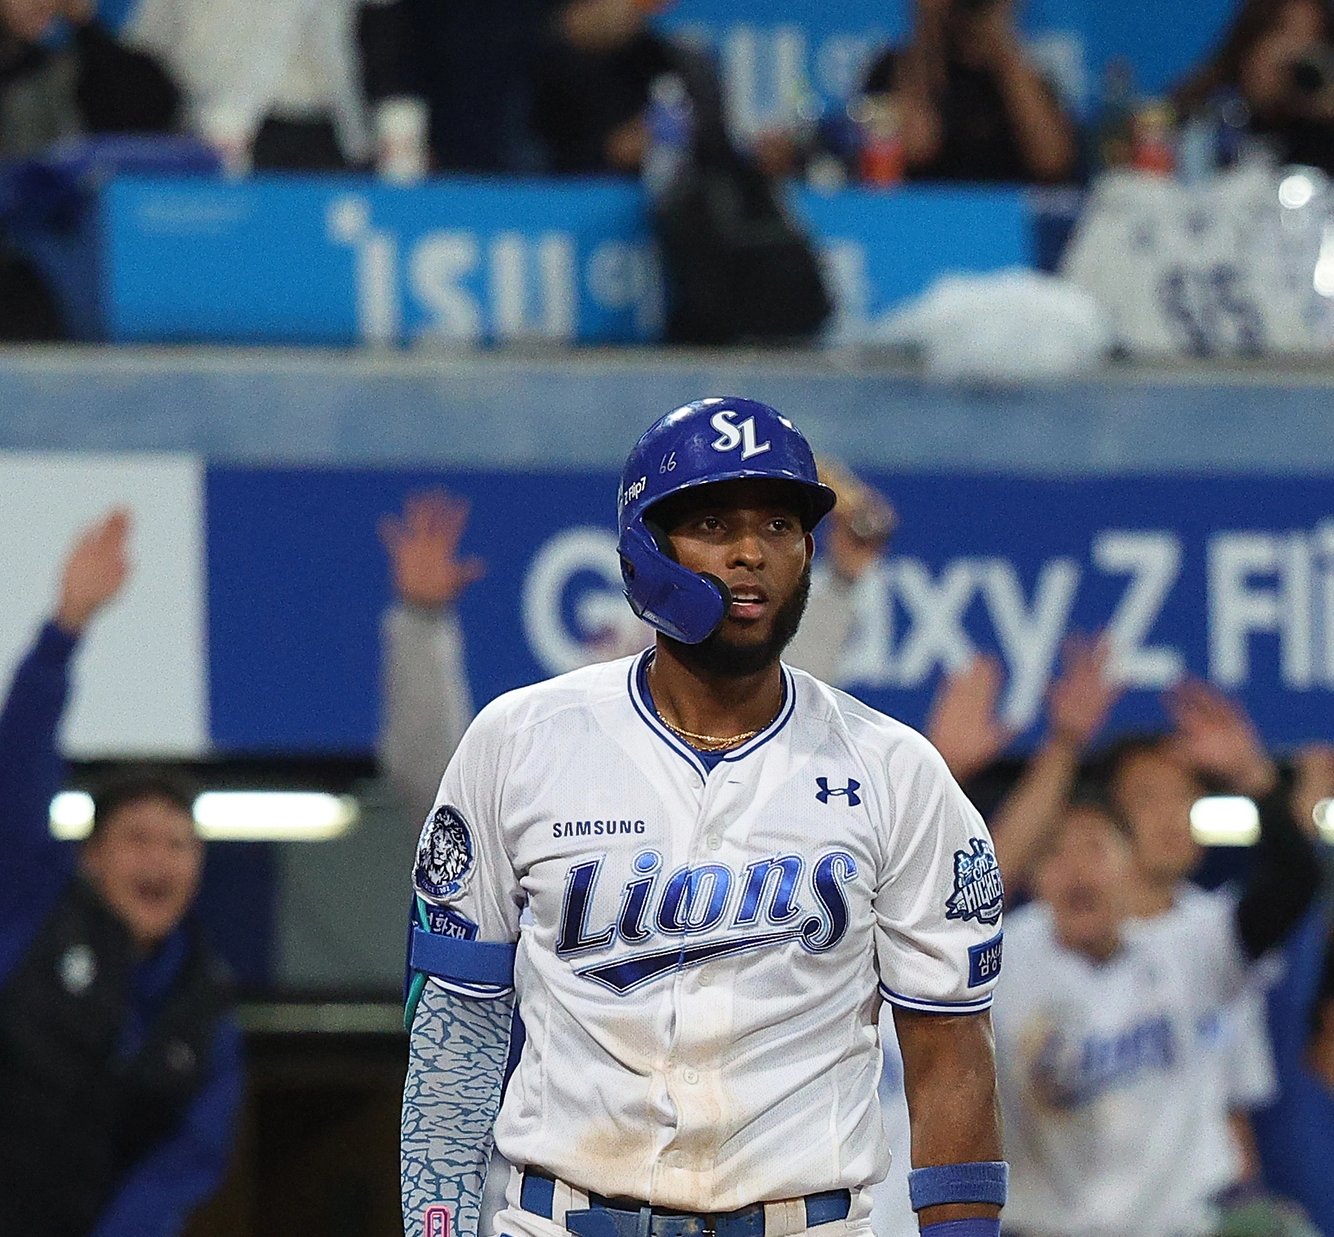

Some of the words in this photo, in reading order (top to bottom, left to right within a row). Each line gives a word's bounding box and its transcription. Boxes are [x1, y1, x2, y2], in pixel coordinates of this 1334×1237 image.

[709, 409, 771, 462] SL
[1090, 529, 1185, 690] Z
[552, 819, 646, 838] SAMSUNG
[554, 847, 859, 955] Lions
